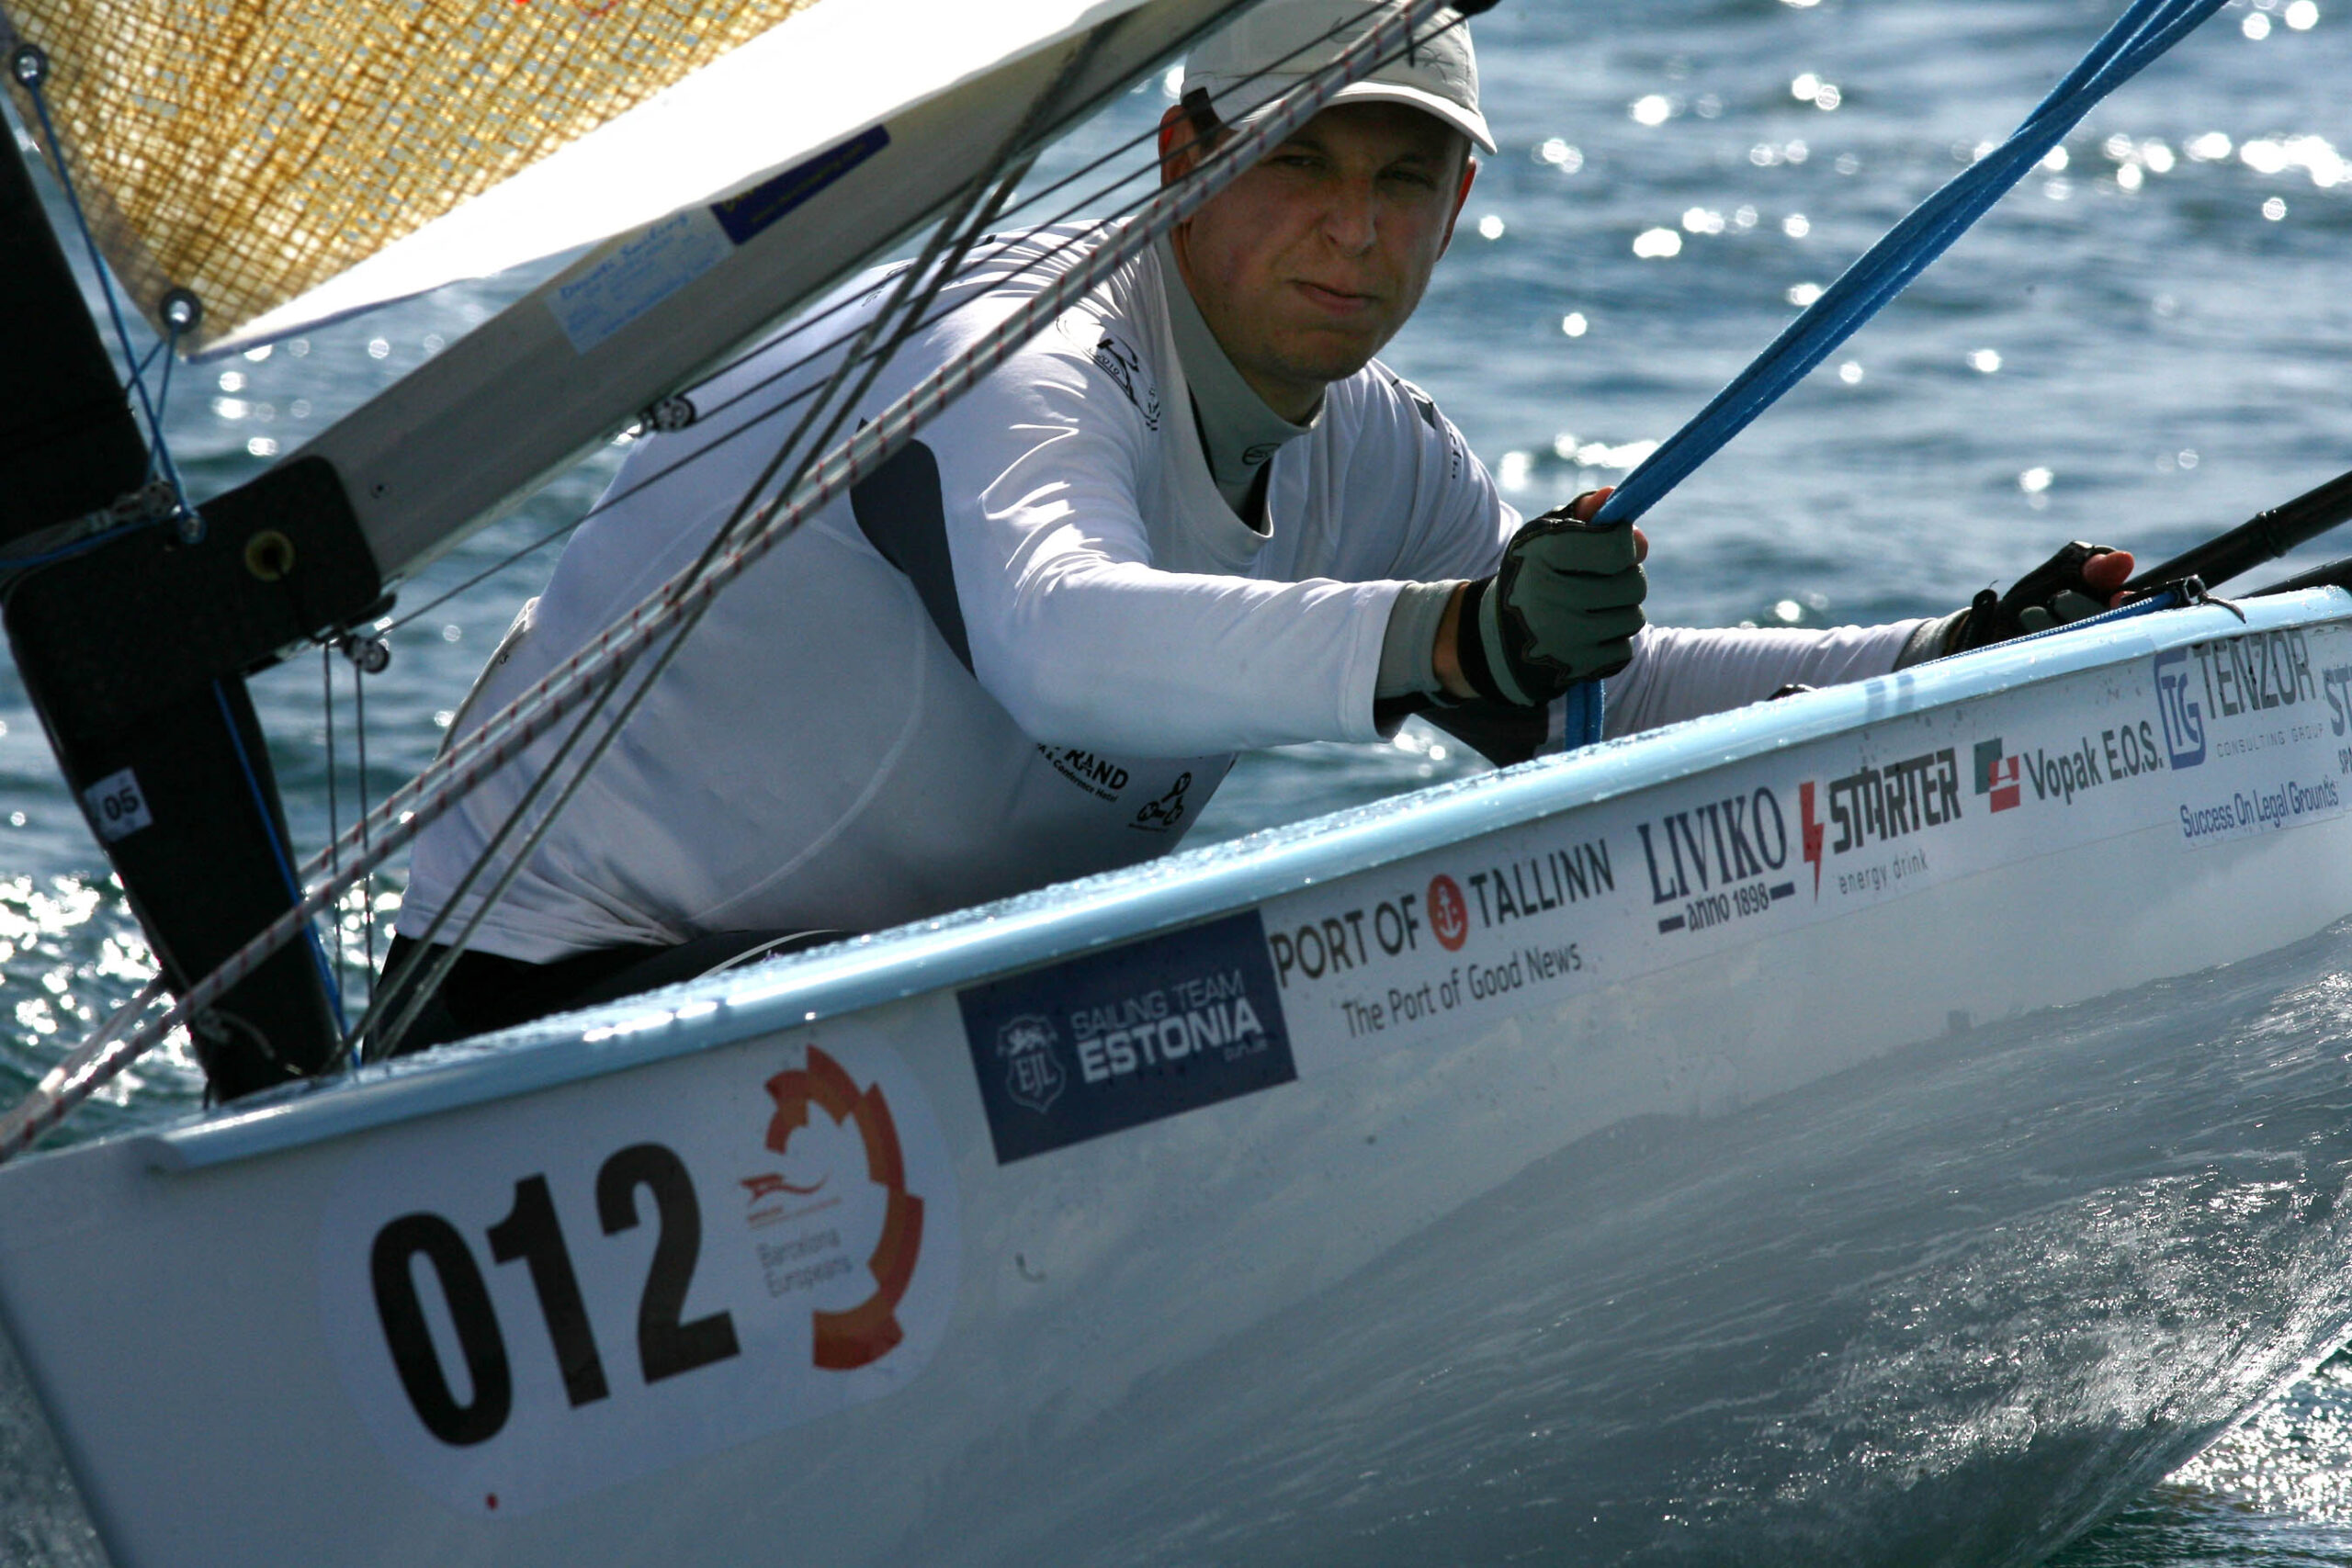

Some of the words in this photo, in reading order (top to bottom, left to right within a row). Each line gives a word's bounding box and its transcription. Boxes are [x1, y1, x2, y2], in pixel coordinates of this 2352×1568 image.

[2190, 626, 2317, 720] TENZOR
[2323, 665, 2352, 737] ST
[2024, 737, 2104, 806] Vopak
[2101, 719, 2164, 782] E.O.S.
[2216, 730, 2287, 759] CONSULTING
[2292, 723, 2325, 745] GROUP
[104, 785, 139, 821] 05
[1828, 746, 1962, 855] STARTER
[2179, 794, 2234, 839] Success
[2233, 792, 2255, 825] On
[2253, 783, 2289, 829] Legal
[2289, 774, 2340, 814] Grounds
[1636, 785, 1788, 906] LIVIKO
[1839, 863, 1888, 896] energy
[1892, 848, 1930, 879] drink
[1269, 908, 1370, 990] PORT
[1374, 893, 1420, 956] OF
[1469, 838, 1615, 929] TALLINN
[1686, 891, 1730, 932] anno
[1733, 882, 1770, 919] 1898
[1070, 989, 1169, 1041] SAILING
[1171, 969, 1246, 1010] TEAM
[1341, 999, 1385, 1039] The
[1388, 986, 1435, 1025] Port
[1440, 966, 1463, 1010] of
[1467, 957, 1522, 1001] Good
[1525, 942, 1583, 984] News
[1076, 997, 1264, 1084] ESTONIA
[370, 1142, 741, 1449] 012
